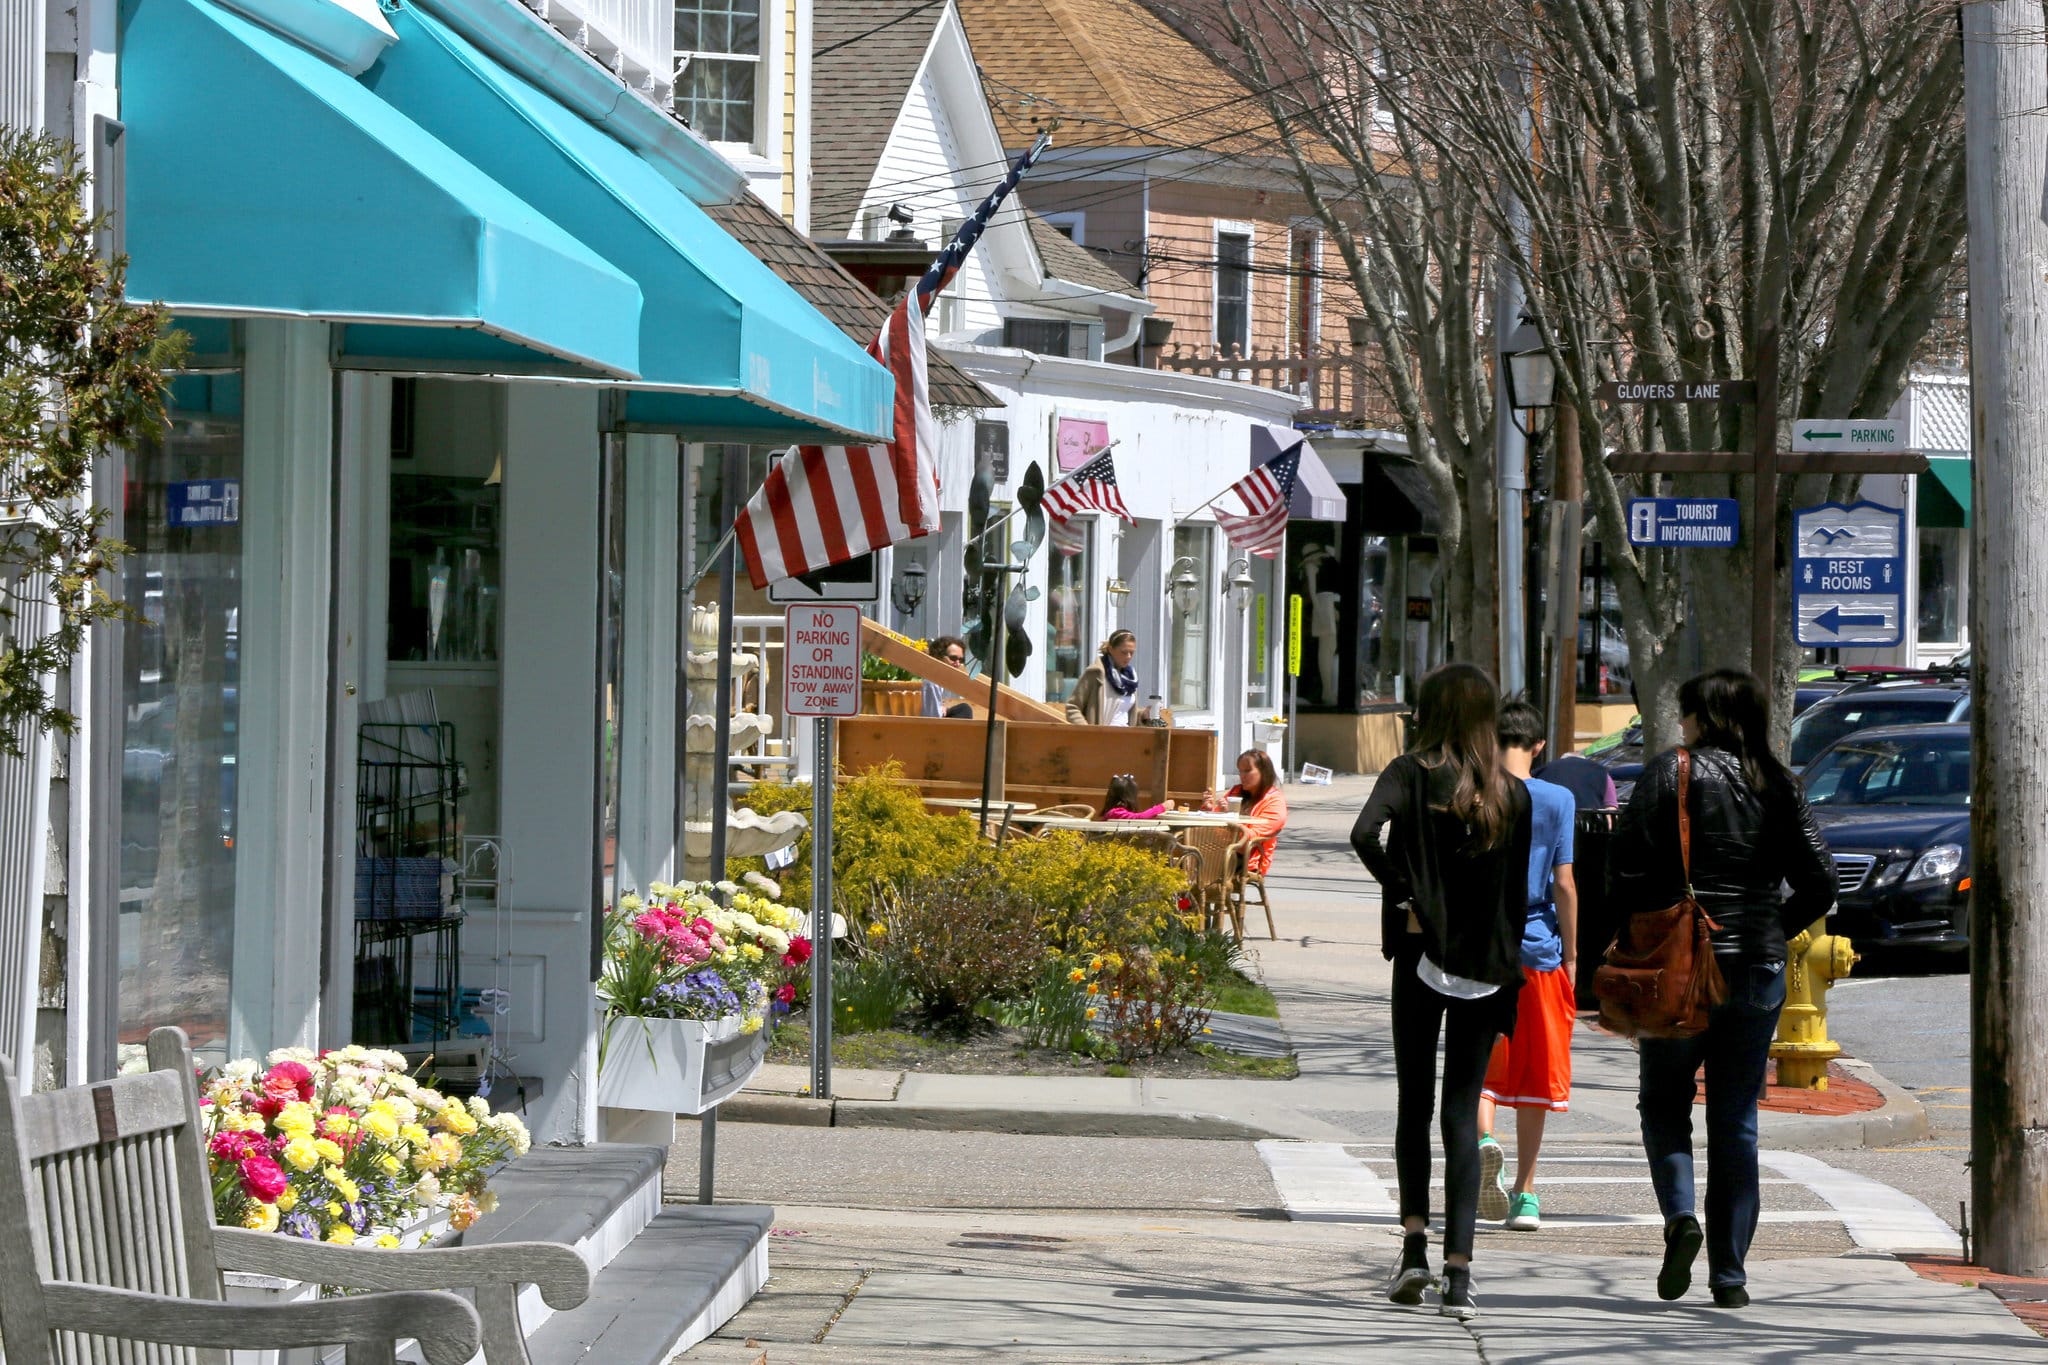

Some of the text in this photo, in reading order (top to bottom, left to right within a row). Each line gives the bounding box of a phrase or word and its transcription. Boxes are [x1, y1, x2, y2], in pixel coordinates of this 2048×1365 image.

[1617, 384, 1720, 399] GLOVERS LANE
[1851, 429, 1895, 443] PARKING
[1676, 504, 1718, 520] TOURIST
[1661, 526, 1731, 541] INFORMATION
[1829, 561, 1864, 574] REST
[1822, 576, 1872, 590] ROOMS
[812, 613, 834, 628] NO
[796, 630, 850, 646] PARKING
[812, 648, 833, 662] OR
[792, 665, 853, 680] STANDING
[790, 682, 854, 694] TOW AWAY
[804, 696, 839, 707] ZONE
